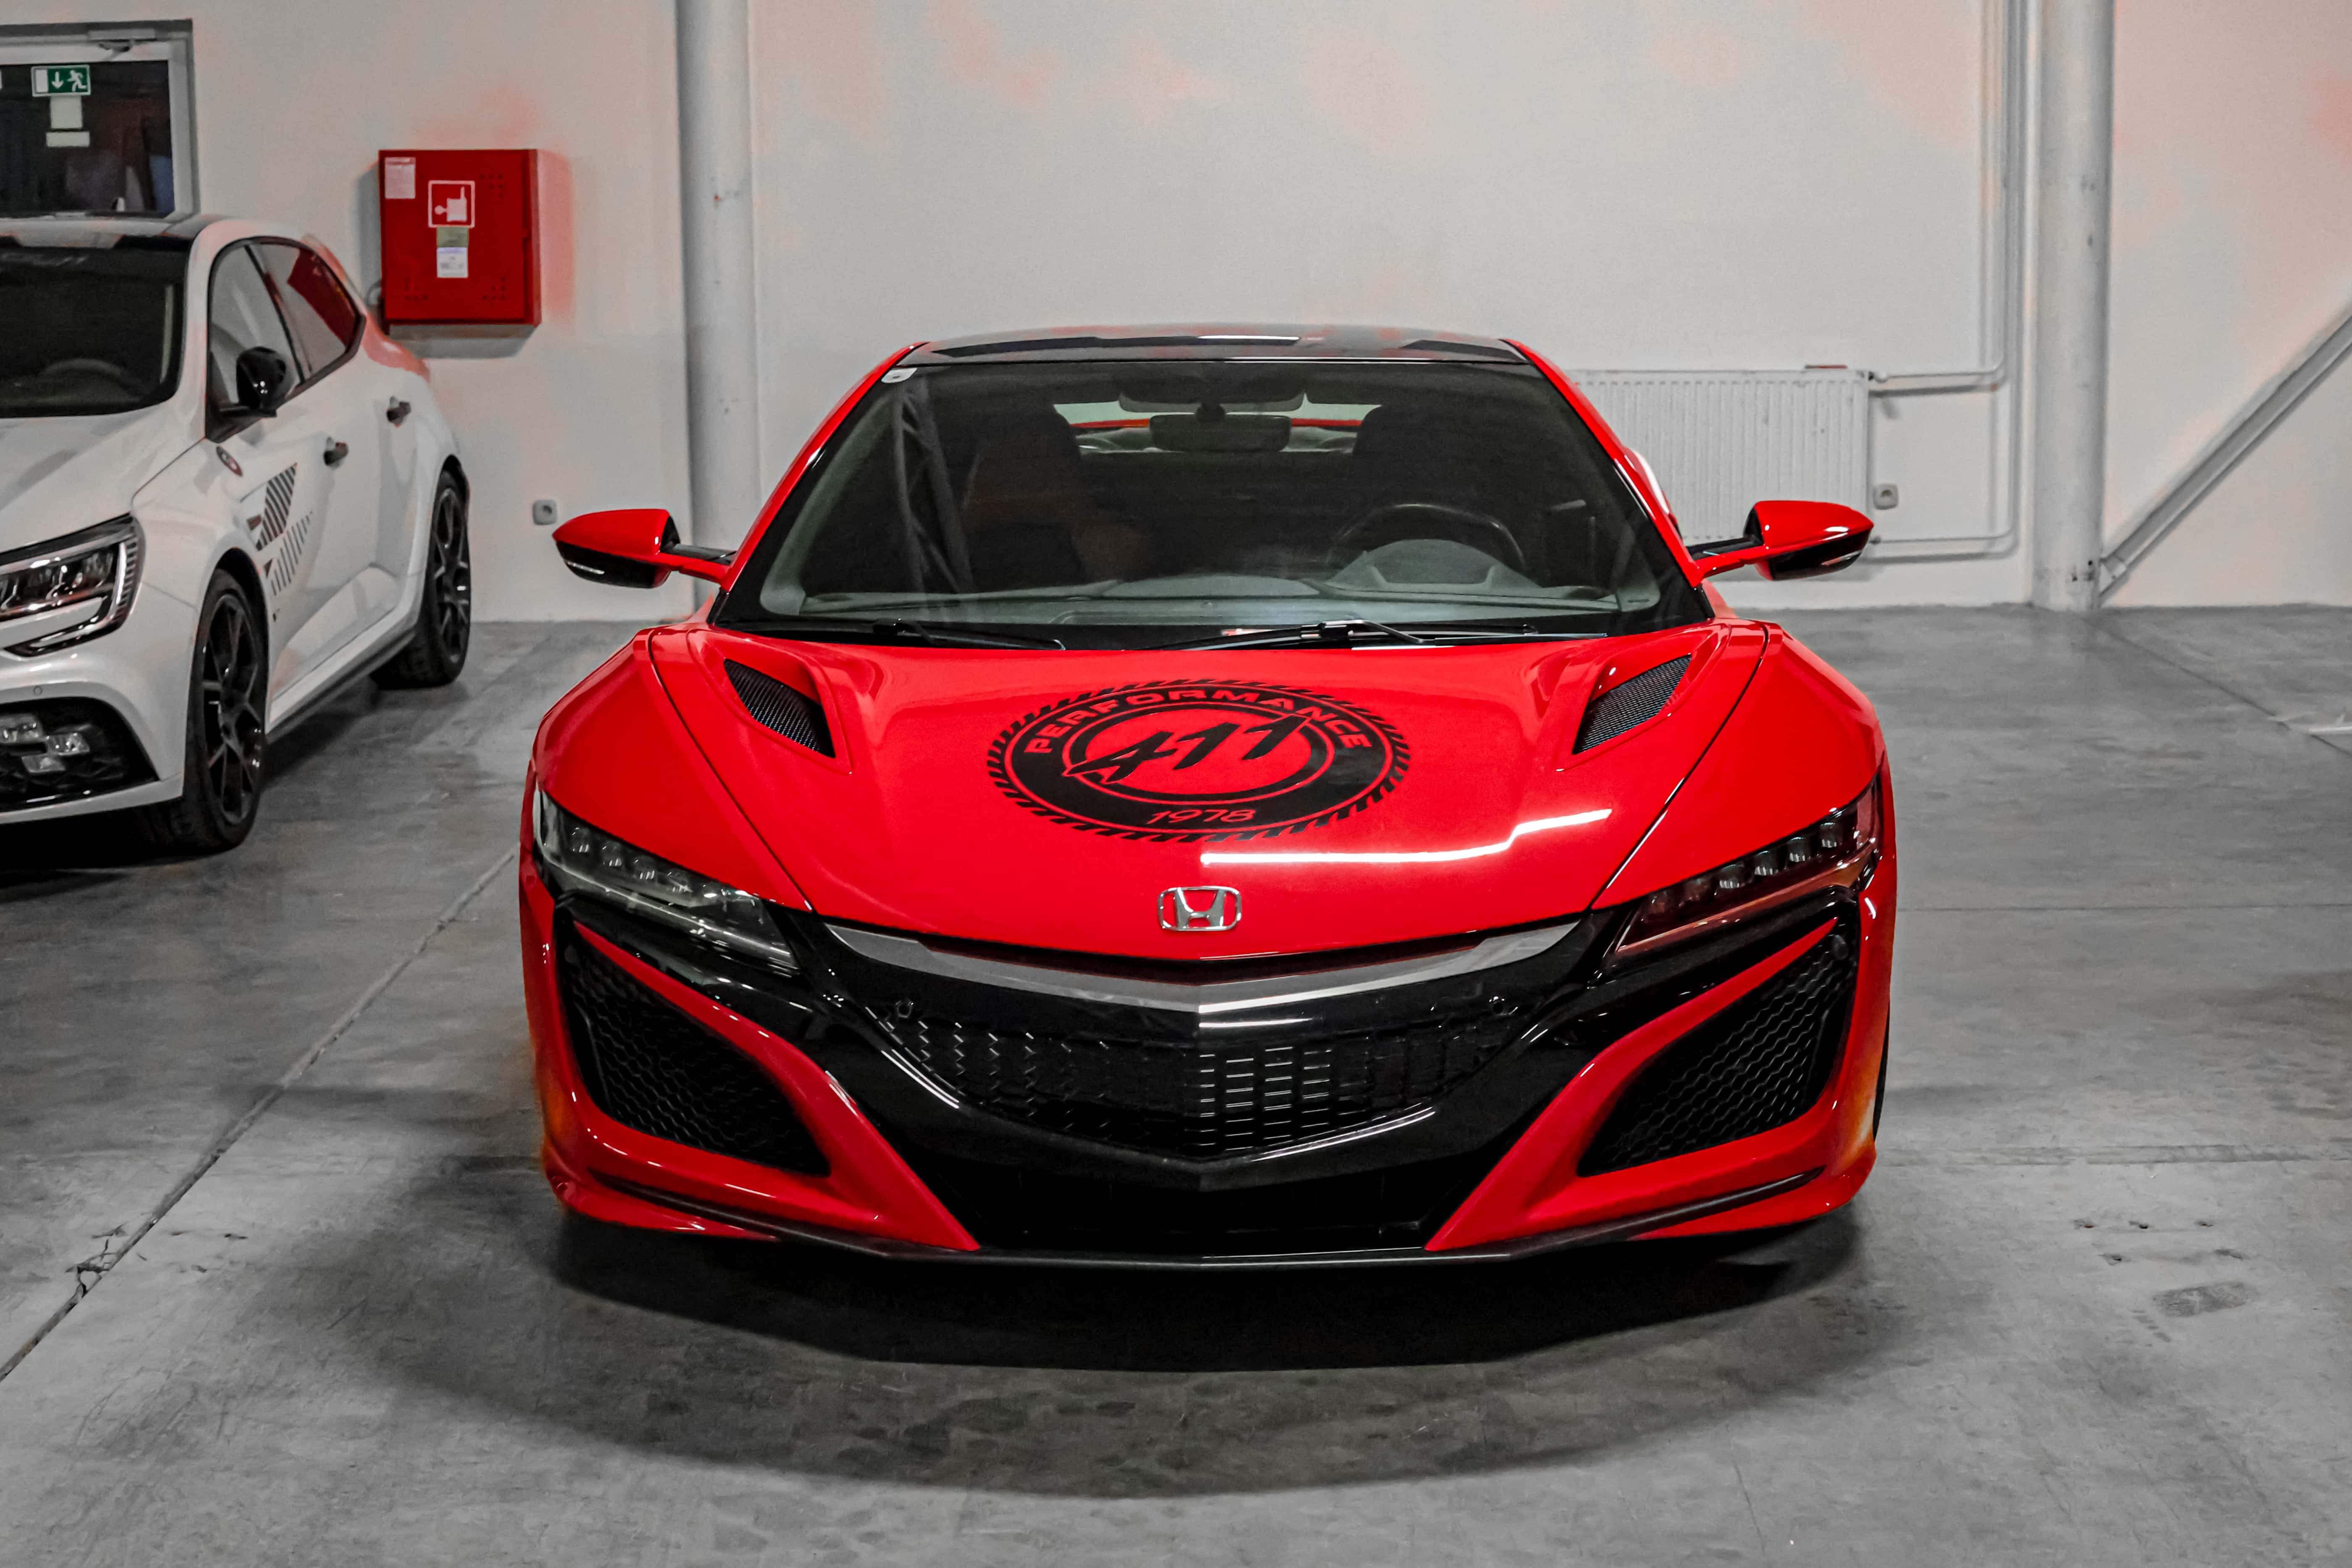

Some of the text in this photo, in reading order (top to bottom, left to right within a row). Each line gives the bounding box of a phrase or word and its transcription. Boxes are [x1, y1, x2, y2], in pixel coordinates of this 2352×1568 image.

[1024, 689, 1372, 753] PERFORMANCE
[1066, 714, 1310, 783] 411
[1146, 809, 1256, 825] 1978
